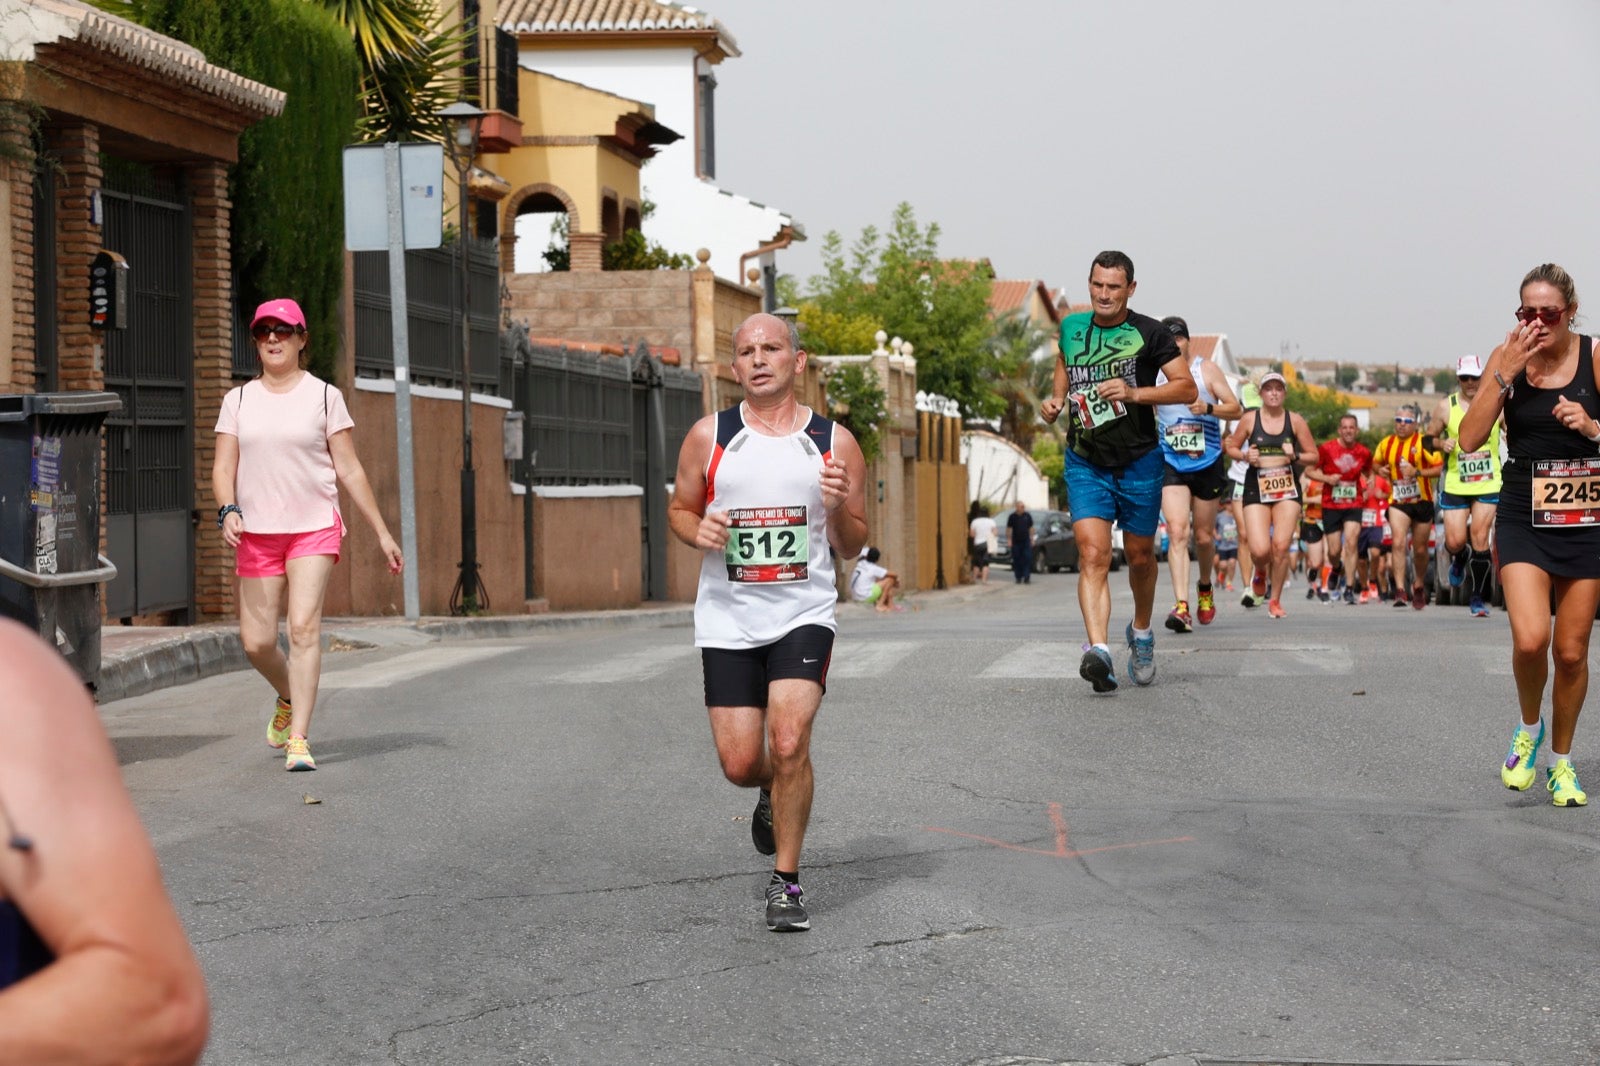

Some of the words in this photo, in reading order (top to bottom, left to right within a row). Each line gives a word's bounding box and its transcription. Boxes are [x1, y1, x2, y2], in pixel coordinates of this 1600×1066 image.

[1171, 435, 1198, 448] 464
[1460, 460, 1491, 474] 1041
[1264, 476, 1292, 491] 2093
[1544, 481, 1600, 503] 2245
[738, 530, 796, 559] 512
